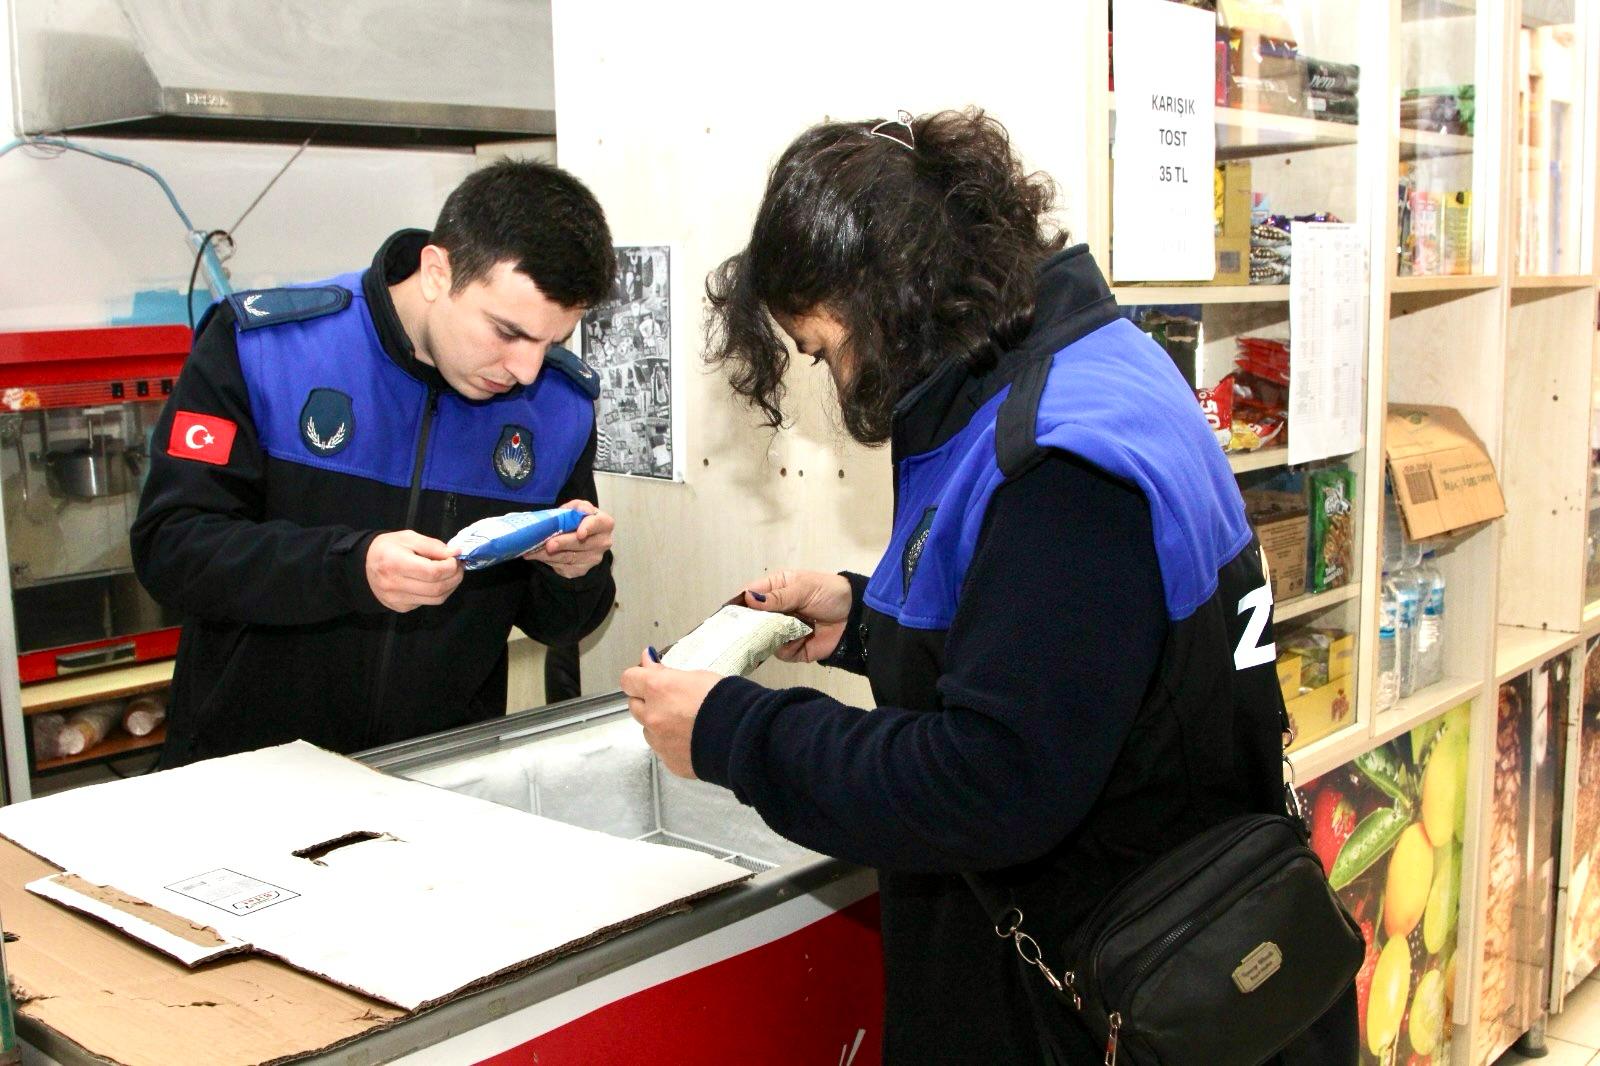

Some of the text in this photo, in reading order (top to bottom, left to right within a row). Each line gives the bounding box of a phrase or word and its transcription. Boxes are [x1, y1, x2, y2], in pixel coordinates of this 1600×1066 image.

[1151, 94, 1195, 118] KARIŞIK
[1159, 128, 1187, 147] TOST
[1159, 165, 1188, 183] 35 TL
